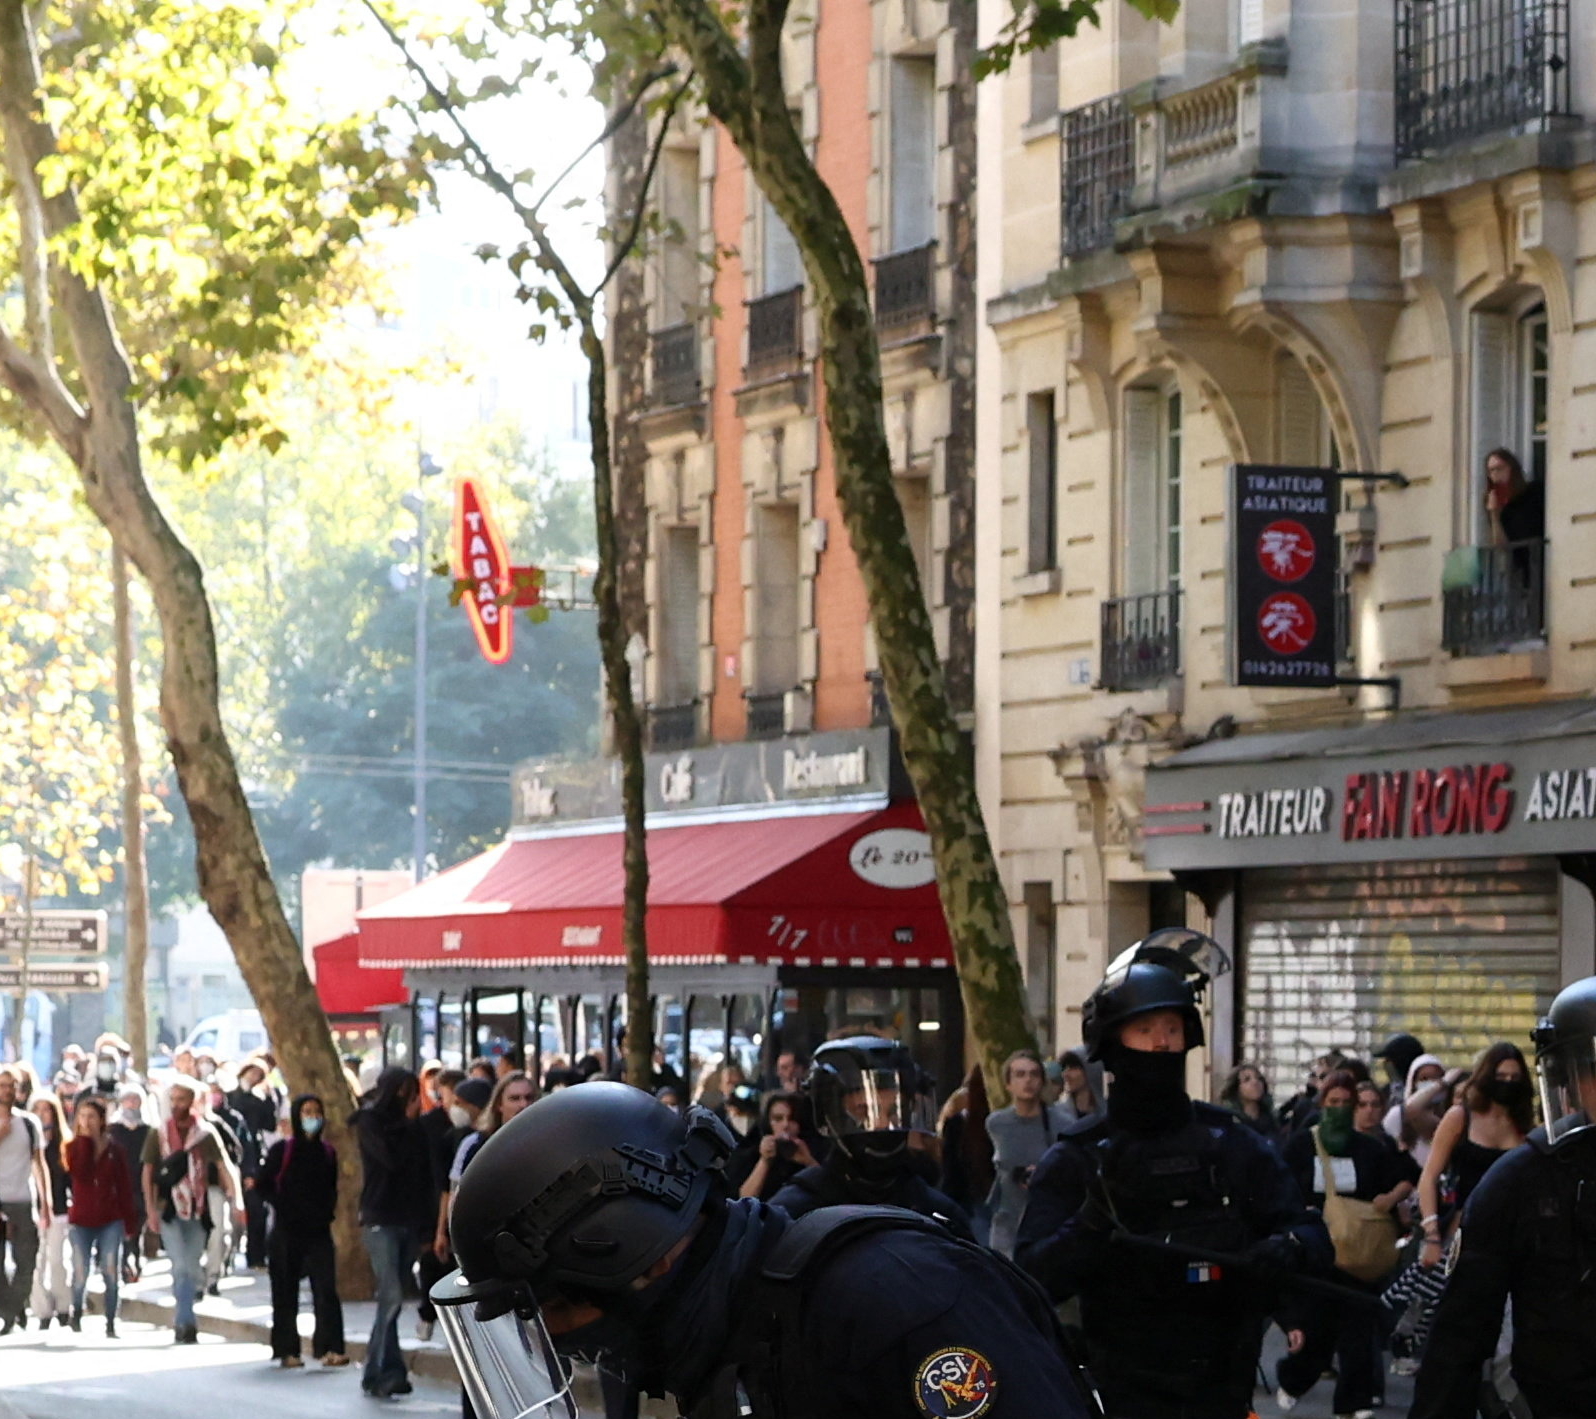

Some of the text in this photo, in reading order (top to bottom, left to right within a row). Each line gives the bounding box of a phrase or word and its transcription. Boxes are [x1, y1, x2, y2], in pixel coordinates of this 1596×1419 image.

[1246, 475, 1323, 493] TRAITEUR
[1242, 496, 1328, 514] ASIATIQUE
[464, 512, 499, 625] TABAC
[1217, 785, 1327, 839] TRAITEUR
[1340, 769, 1402, 842] FAN
[1408, 761, 1512, 839] RONG
[926, 1356, 969, 1391] CSI
